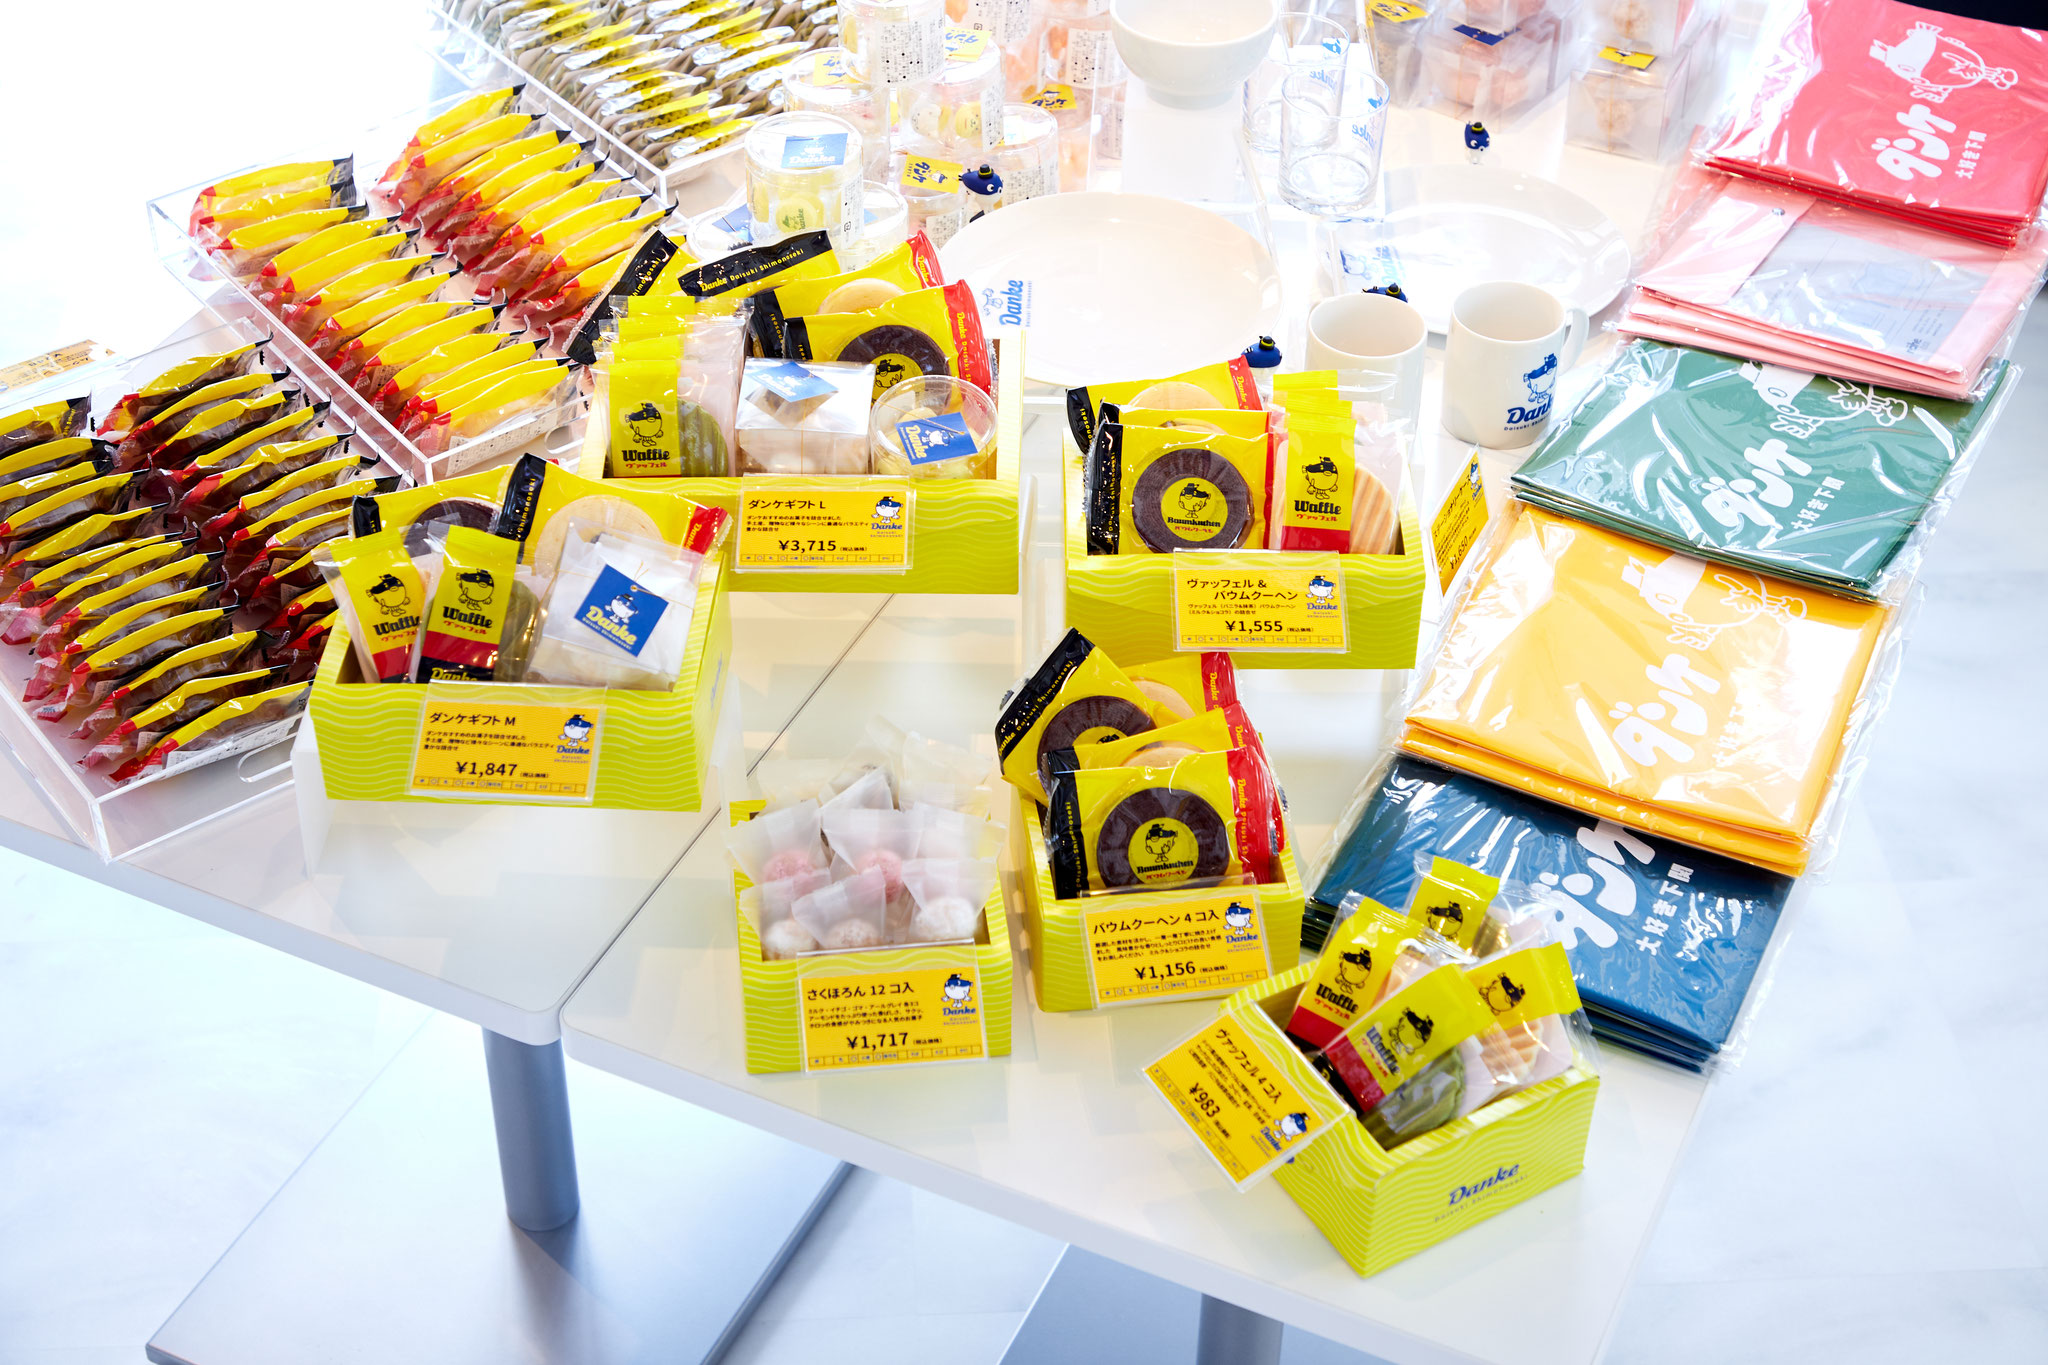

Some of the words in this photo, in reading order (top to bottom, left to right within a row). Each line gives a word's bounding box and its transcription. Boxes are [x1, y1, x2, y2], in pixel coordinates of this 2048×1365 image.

[1871, 104, 1956, 180] ダンケ
[912, 162, 932, 183] ダンケ
[630, 257, 662, 296] himonoseki
[700, 277, 728, 292] Danke
[730, 268, 758, 282] Daisuki
[760, 248, 804, 272] Shimonoseki
[999, 280, 1024, 326] Danke
[956, 312, 968, 340] Danke
[1506, 394, 1552, 424] Dank
[906, 424, 928, 458] Danke
[622, 449, 670, 462] Waffle
[1701, 438, 1812, 528] ダンケ
[748, 500, 816, 510] ダンケギフト
[820, 500, 826, 509] L
[1294, 500, 1342, 514] Waffle
[1168, 516, 1220, 528] Baumkuchen
[778, 540, 836, 553] ¥3,715
[1187, 578, 1254, 588] ヴァッフェル
[1257, 580, 1267, 588] &
[1214, 591, 1298, 600] バウムクーヘン
[373, 616, 420, 636] Waffl
[443, 606, 492, 628] Waffle
[586, 606, 636, 645] Danke
[1225, 620, 1283, 634] ¥1,555
[1209, 672, 1220, 702] Danke
[430, 712, 500, 726] ダンケギフト
[504, 716, 516, 726] M
[1608, 653, 1720, 767] ダンケ
[1235, 724, 1246, 748] Dan
[556, 744, 590, 754] Danke
[456, 761, 518, 778] ¥1,847
[1236, 778, 1246, 808] Danke
[1136, 860, 1194, 874] Baumkuchen
[1530, 820, 1656, 950] ダンケ
[1636, 862, 1694, 956] 大好き下関
[1094, 916, 1180, 934] バウムクーヘン
[1226, 932, 1258, 944] Danke
[1134, 960, 1196, 981] ¥1,156
[807, 986, 866, 1000] さくほろん
[1316, 982, 1358, 1014] Waffle
[942, 1006, 976, 1016] Danke
[846, 1032, 908, 1051] ¥1,717
[1215, 1028, 1260, 1077] ヴァッフェル
[1366, 1026, 1400, 1076] Waffle
[1189, 1082, 1220, 1118] ¥983
[1448, 1164, 1520, 1207] Danke
